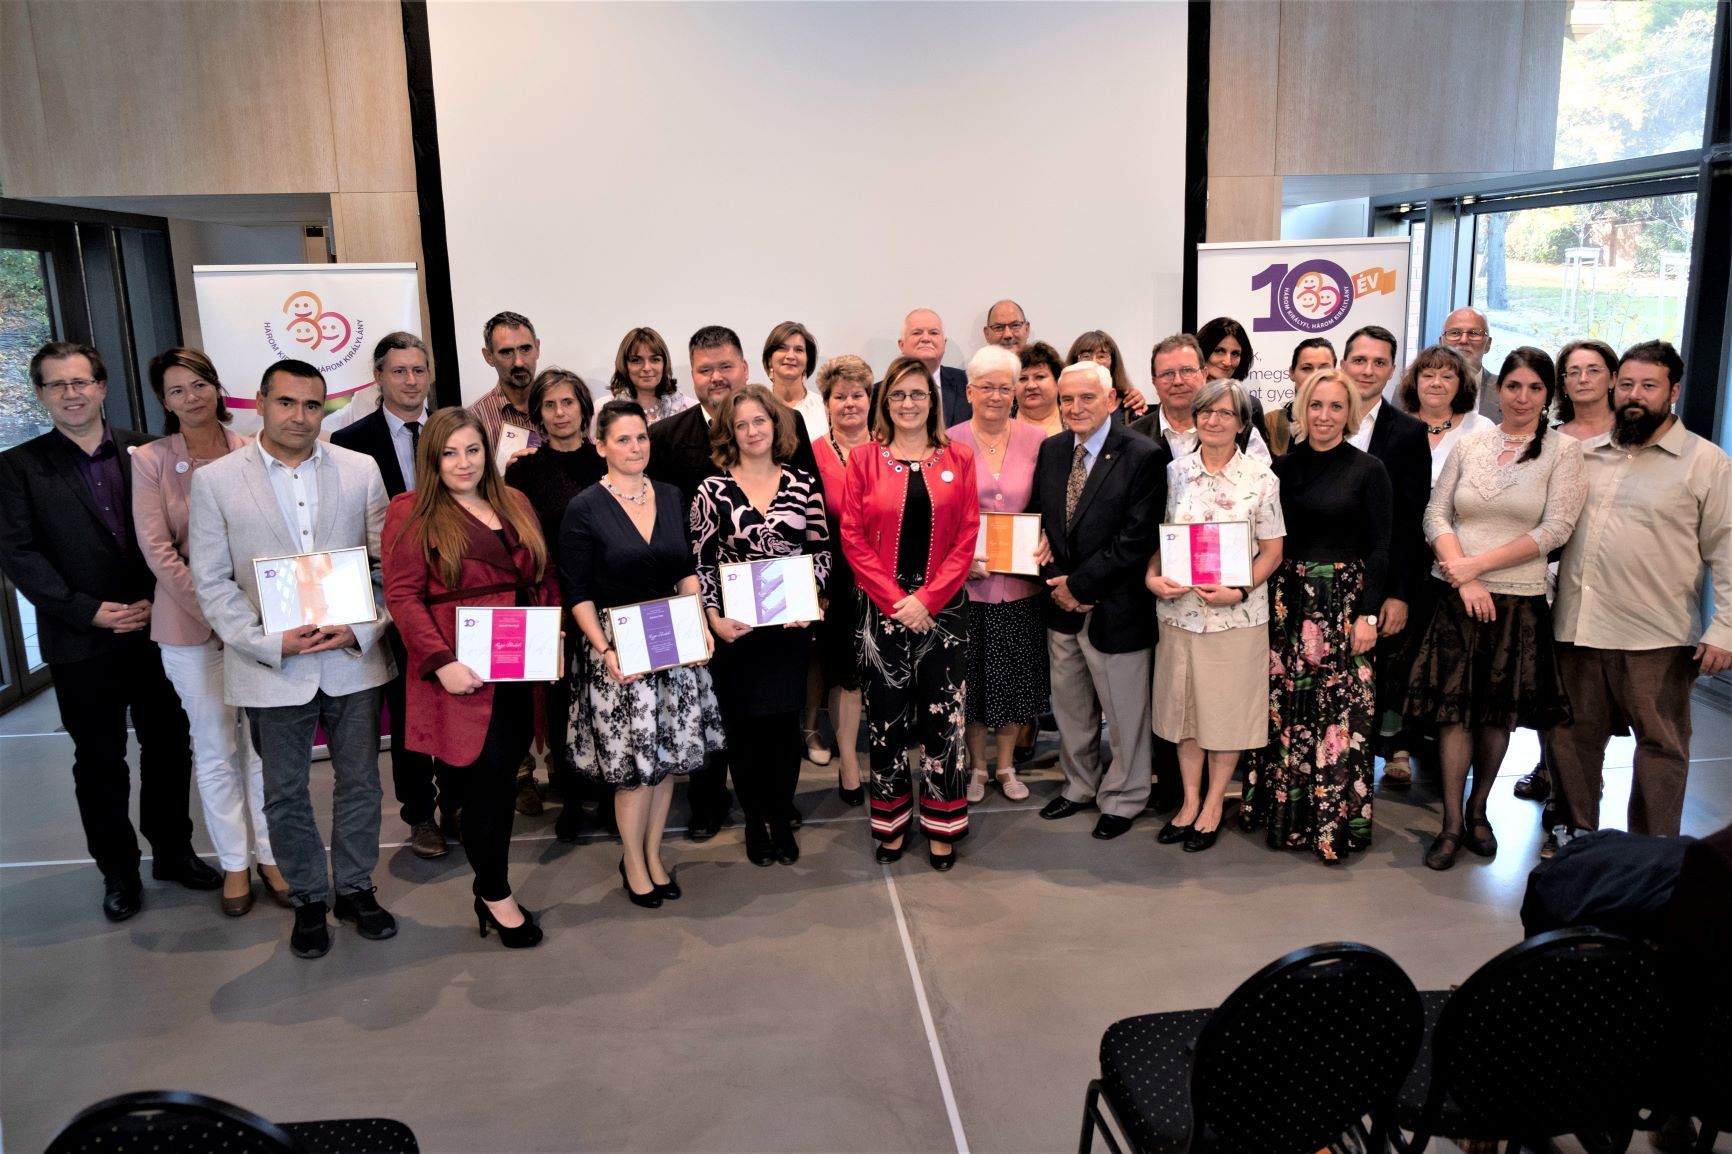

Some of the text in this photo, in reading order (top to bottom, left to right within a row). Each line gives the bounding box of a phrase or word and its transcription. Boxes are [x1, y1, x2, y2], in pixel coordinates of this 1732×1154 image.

[1252, 259, 1354, 333] 10
[1357, 272, 1379, 294] ÉV
[1311, 319, 1335, 329] HÁROM
[1334, 286, 1350, 321] KIRÁLYLÁNY
[264, 322, 279, 352] HÁROM
[342, 319, 364, 364] KIRÁLYLÁNY
[1249, 369, 1290, 383] megs
[1266, 388, 1297, 403] gye
